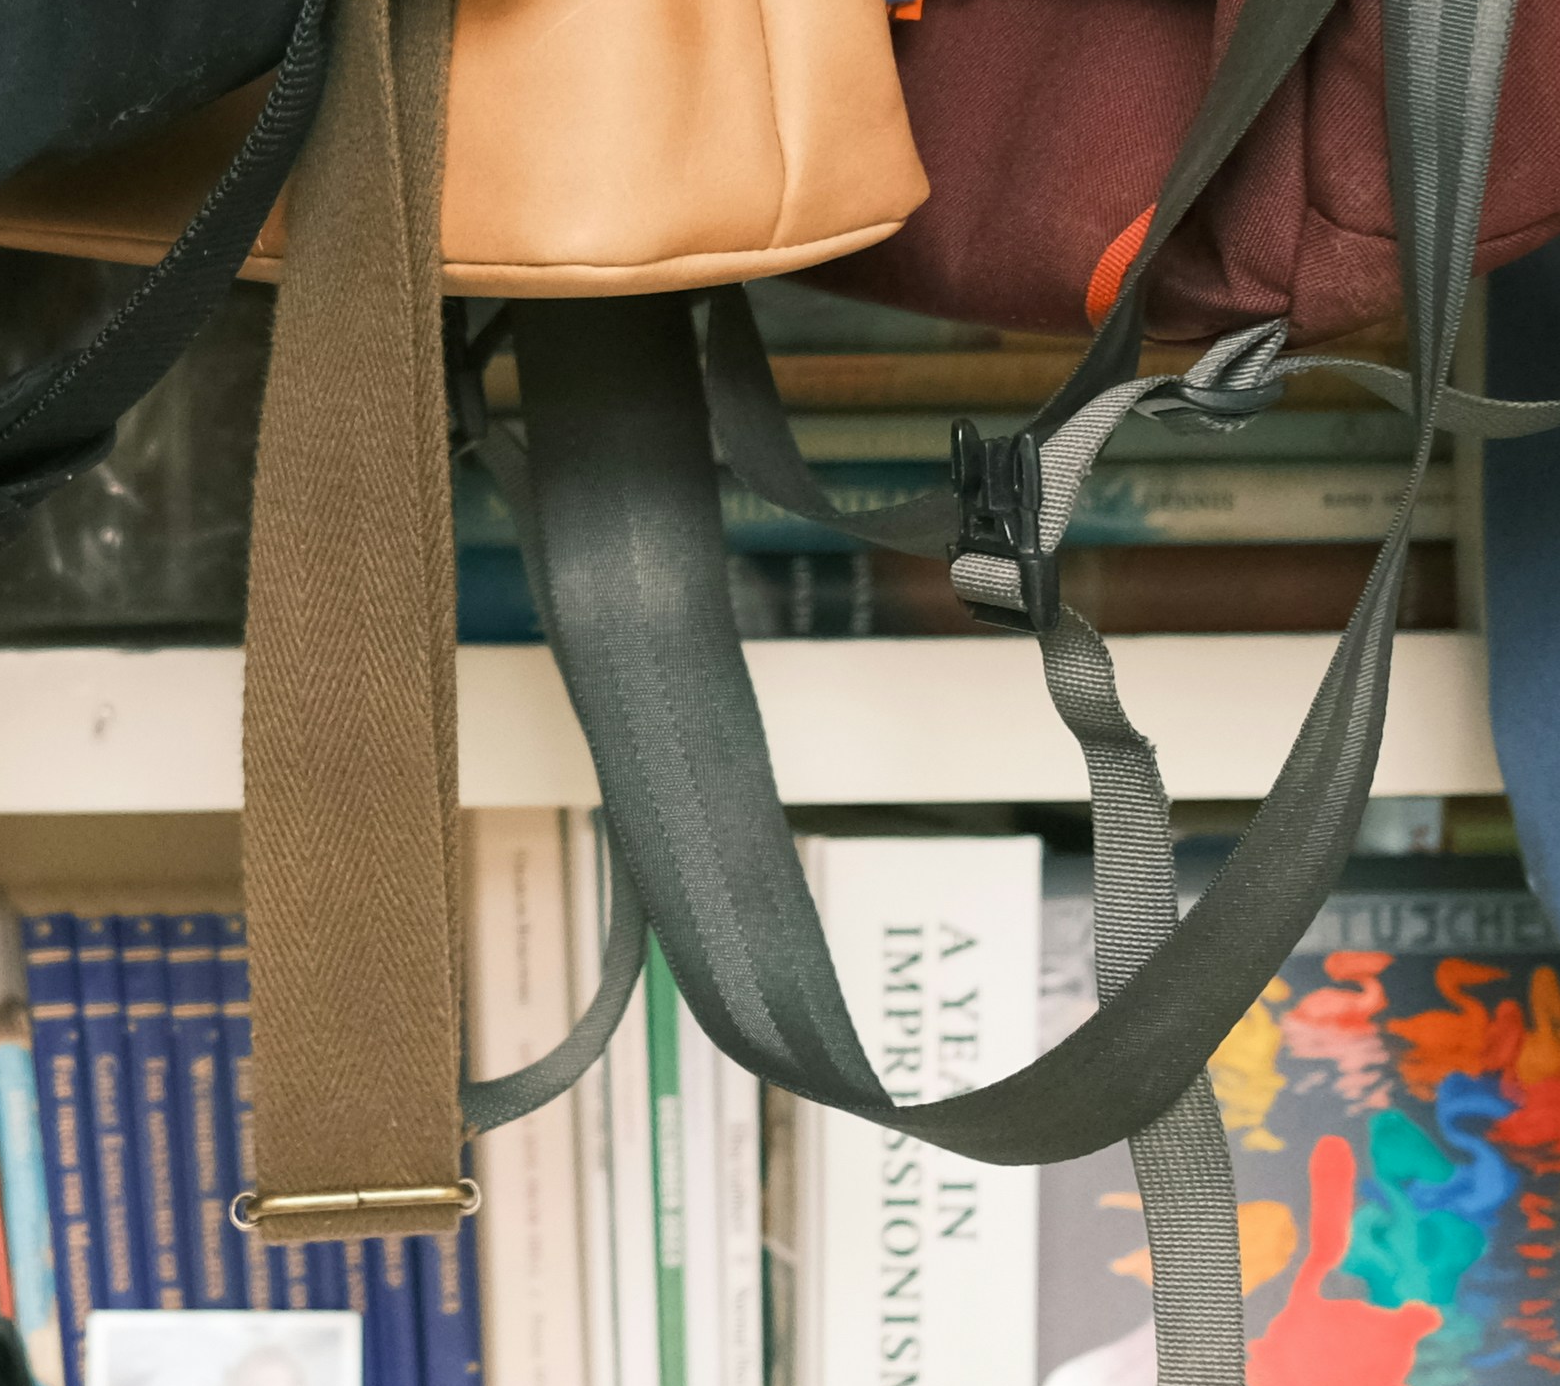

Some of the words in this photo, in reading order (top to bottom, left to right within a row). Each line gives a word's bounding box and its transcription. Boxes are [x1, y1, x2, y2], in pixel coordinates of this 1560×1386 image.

[937, 922, 980, 958] A
[936, 988, 980, 1156] YEA
[937, 1181, 980, 1243] IN
